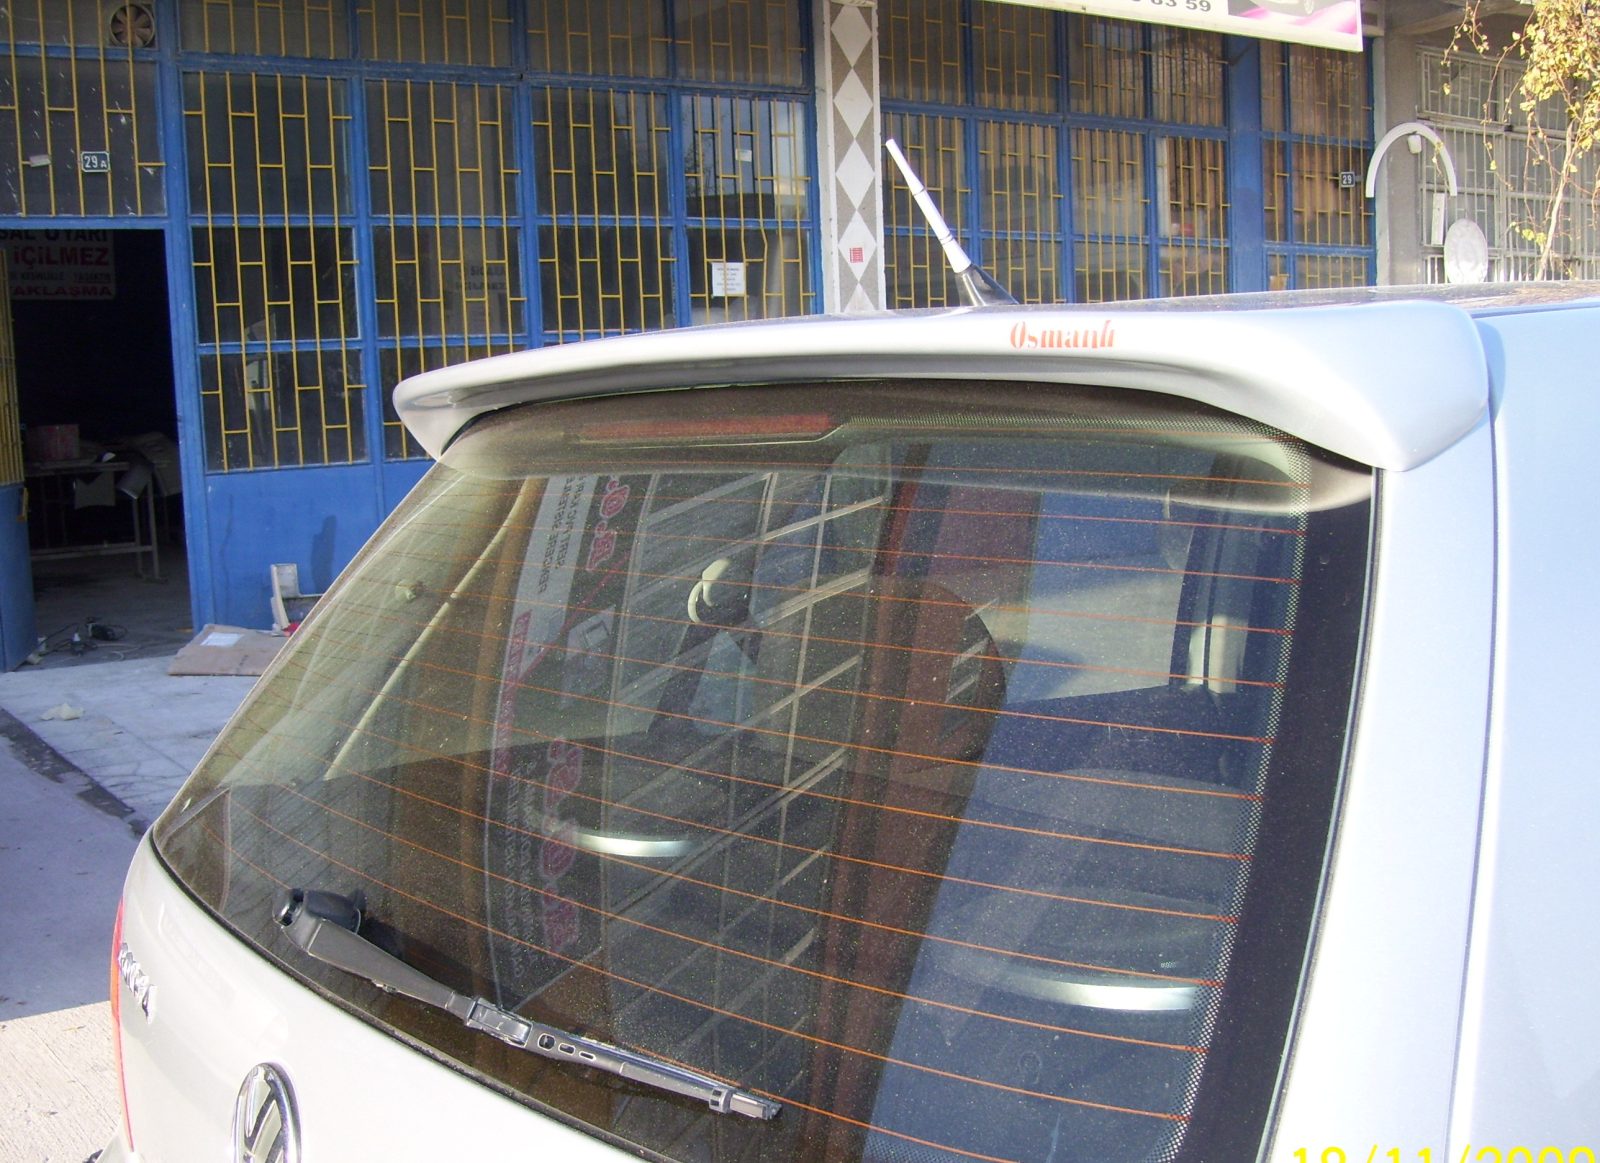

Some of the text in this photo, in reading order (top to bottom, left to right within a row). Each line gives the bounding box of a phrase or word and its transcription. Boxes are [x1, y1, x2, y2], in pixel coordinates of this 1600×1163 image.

[84, 155, 98, 168] 29
[1342, 174, 1351, 184] 29
[11, 286, 112, 297] AKLAŞMA
